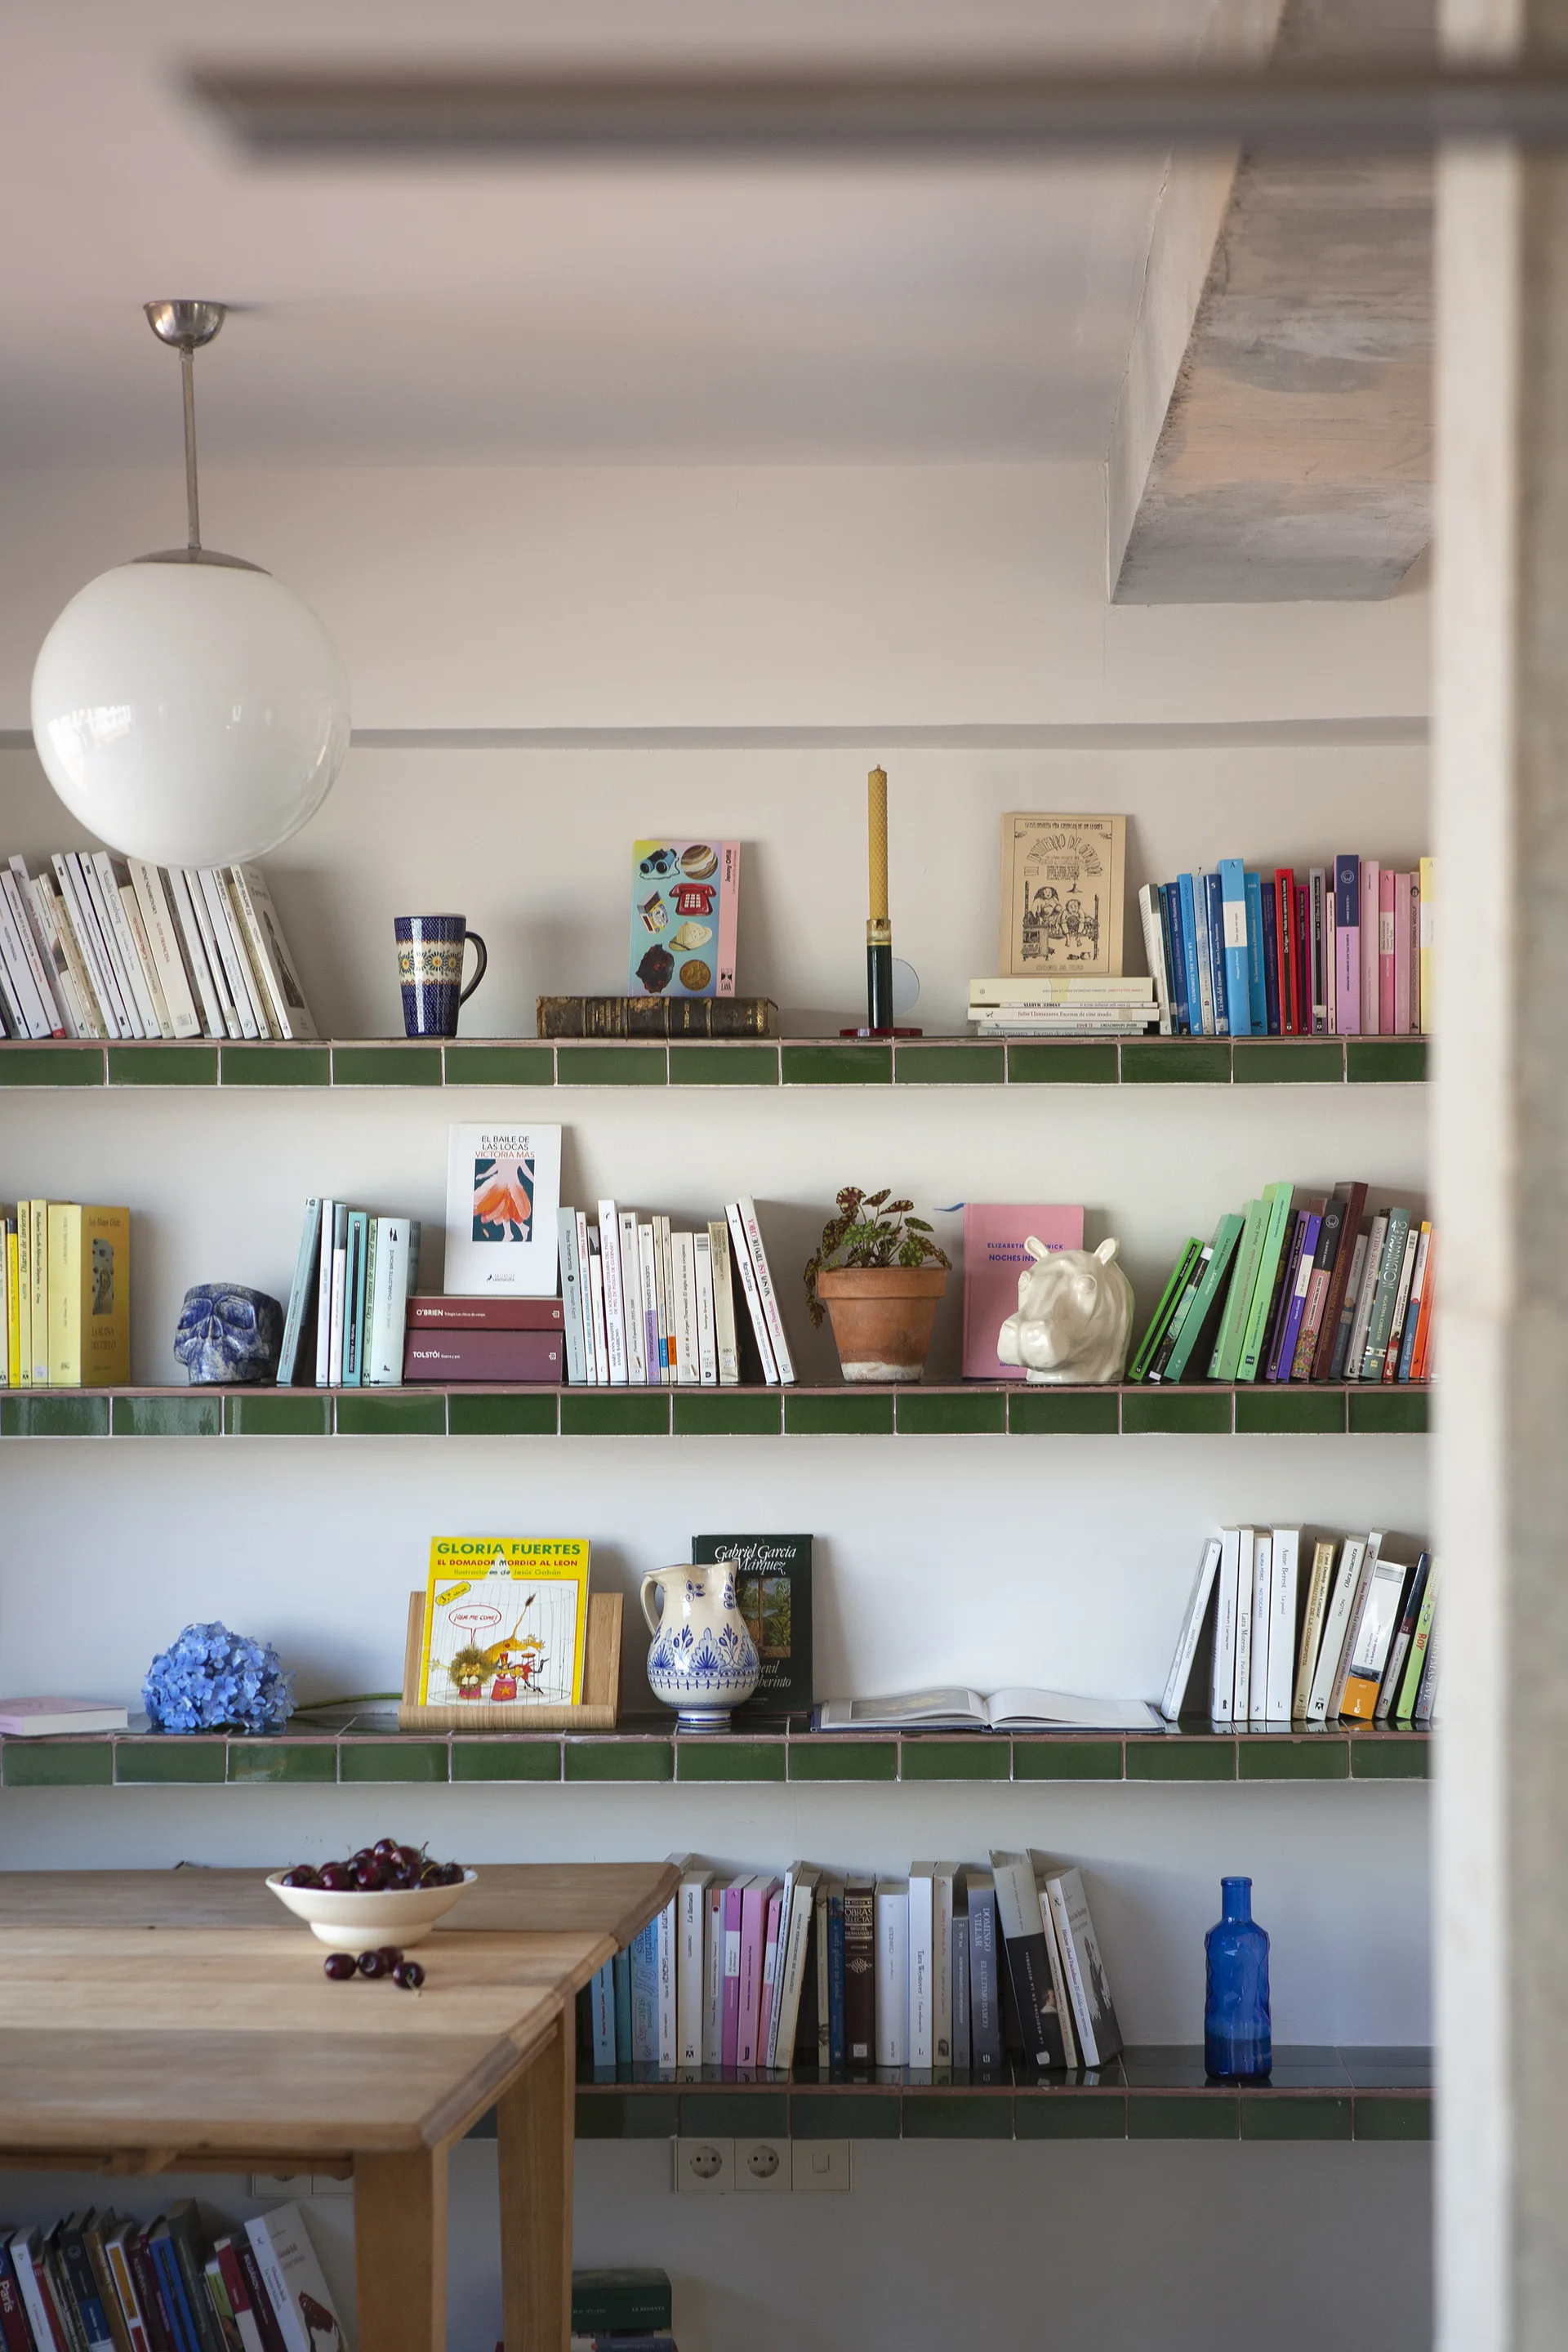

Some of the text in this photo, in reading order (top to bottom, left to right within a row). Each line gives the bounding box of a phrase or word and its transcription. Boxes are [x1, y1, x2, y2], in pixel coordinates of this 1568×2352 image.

[101, 870, 114, 894] Natalia
[108, 893, 123, 924] Ginzburg
[239, 889, 251, 908] nervio
[246, 908, 253, 916] El
[721, 982, 731, 991] LAVA
[481, 1135, 529, 1143] EL BAILE DE
[368, 1225, 376, 1241] tango
[20, 1240, 26, 1248] de
[746, 1218, 771, 1296] NO SOY ESE TIPO DE CHICA
[1379, 1234, 1405, 1290] PADDINGTON
[745, 1275, 754, 1291] Larrea
[1365, 1270, 1374, 1289] JUAN
[766, 1300, 780, 1337] Lena Dunham
[1374, 1294, 1388, 1341] AGATHA CHRISTIE
[412, 1350, 440, 1358] TOLSTÓI
[437, 1543, 581, 1555] GLORIA FUERTES
[715, 1543, 758, 1562] Gabriel
[1280, 1548, 1290, 1588] Anne Berest
[1346, 1548, 1357, 1572] maestra
[1343, 1572, 1352, 1588] Obra
[1414, 1633, 1427, 1650] BOY
[1423, 1682, 1433, 1700] EVE
[844, 1908, 873, 1917] OBRAS
[982, 1907, 991, 1951] DOMINGO
[832, 1949, 841, 1967] place
[980, 1960, 987, 1968] EL
[834, 1981, 842, 1998] land
